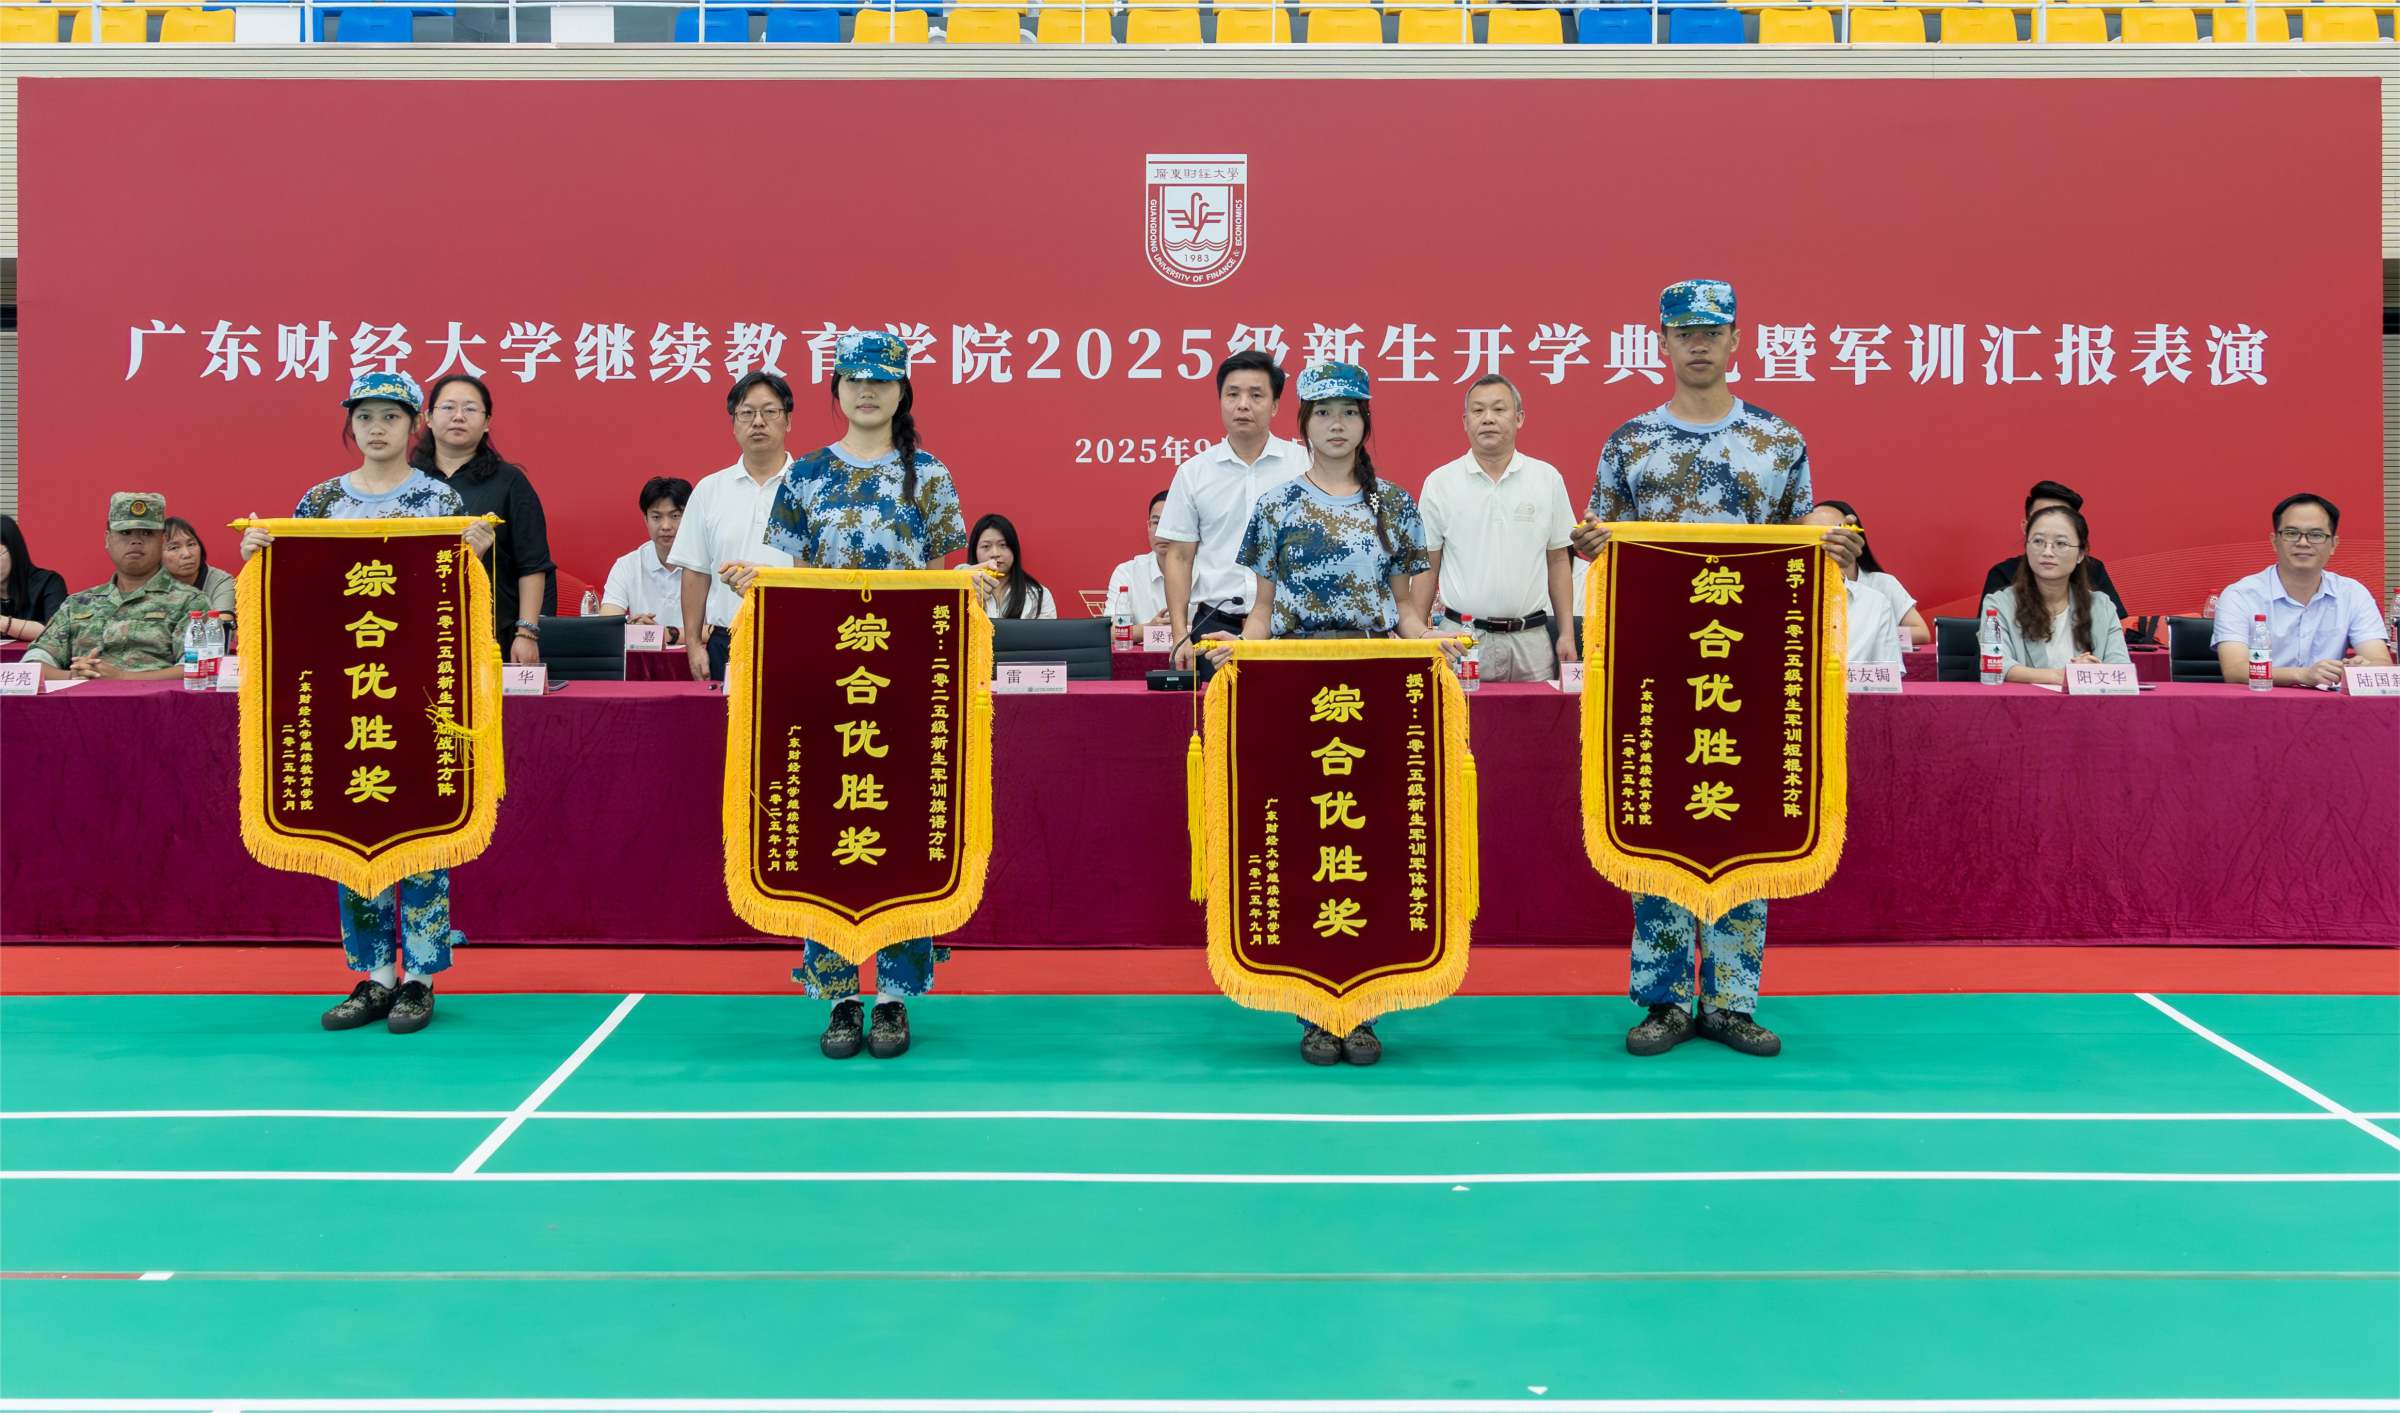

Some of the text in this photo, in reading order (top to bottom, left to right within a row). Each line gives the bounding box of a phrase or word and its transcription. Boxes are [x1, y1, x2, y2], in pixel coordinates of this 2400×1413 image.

[1150, 199, 1158, 252] GUANGDONG
[1153, 253, 1190, 281] UNIVERSITY
[1184, 254, 1210, 263] 1983
[1235, 199, 1243, 246] ECONOMICS
[1206, 258, 1236, 281] FINANCE
[126, 319, 2268, 386] 广东财经大学继续教育学院2025级新生开学典暨军训汇报表演
[343, 559, 399, 803] 综合优胜奖
[1684, 565, 1745, 821] 综合优胜奖
[2076, 669, 2127, 685] 阳文华
[281, 724, 296, 811] 二零二五年九月
[298, 670, 314, 811] 广东财经大学继续教育学院
[831, 612, 892, 866] 综合优胜奖
[1621, 733, 1636, 825] 二零二五年九月
[1638, 677, 1655, 825] 广东财经大学继续教育学院
[767, 781, 783, 872] 二零二五年九月
[785, 725, 802, 872] 广东财经大学继续教育学院
[1309, 683, 1368, 938] 综合优胜奖
[1247, 854, 1263, 946] 二零二五年九月
[1264, 797, 1281, 945] 广东财经大学继续教育学院
